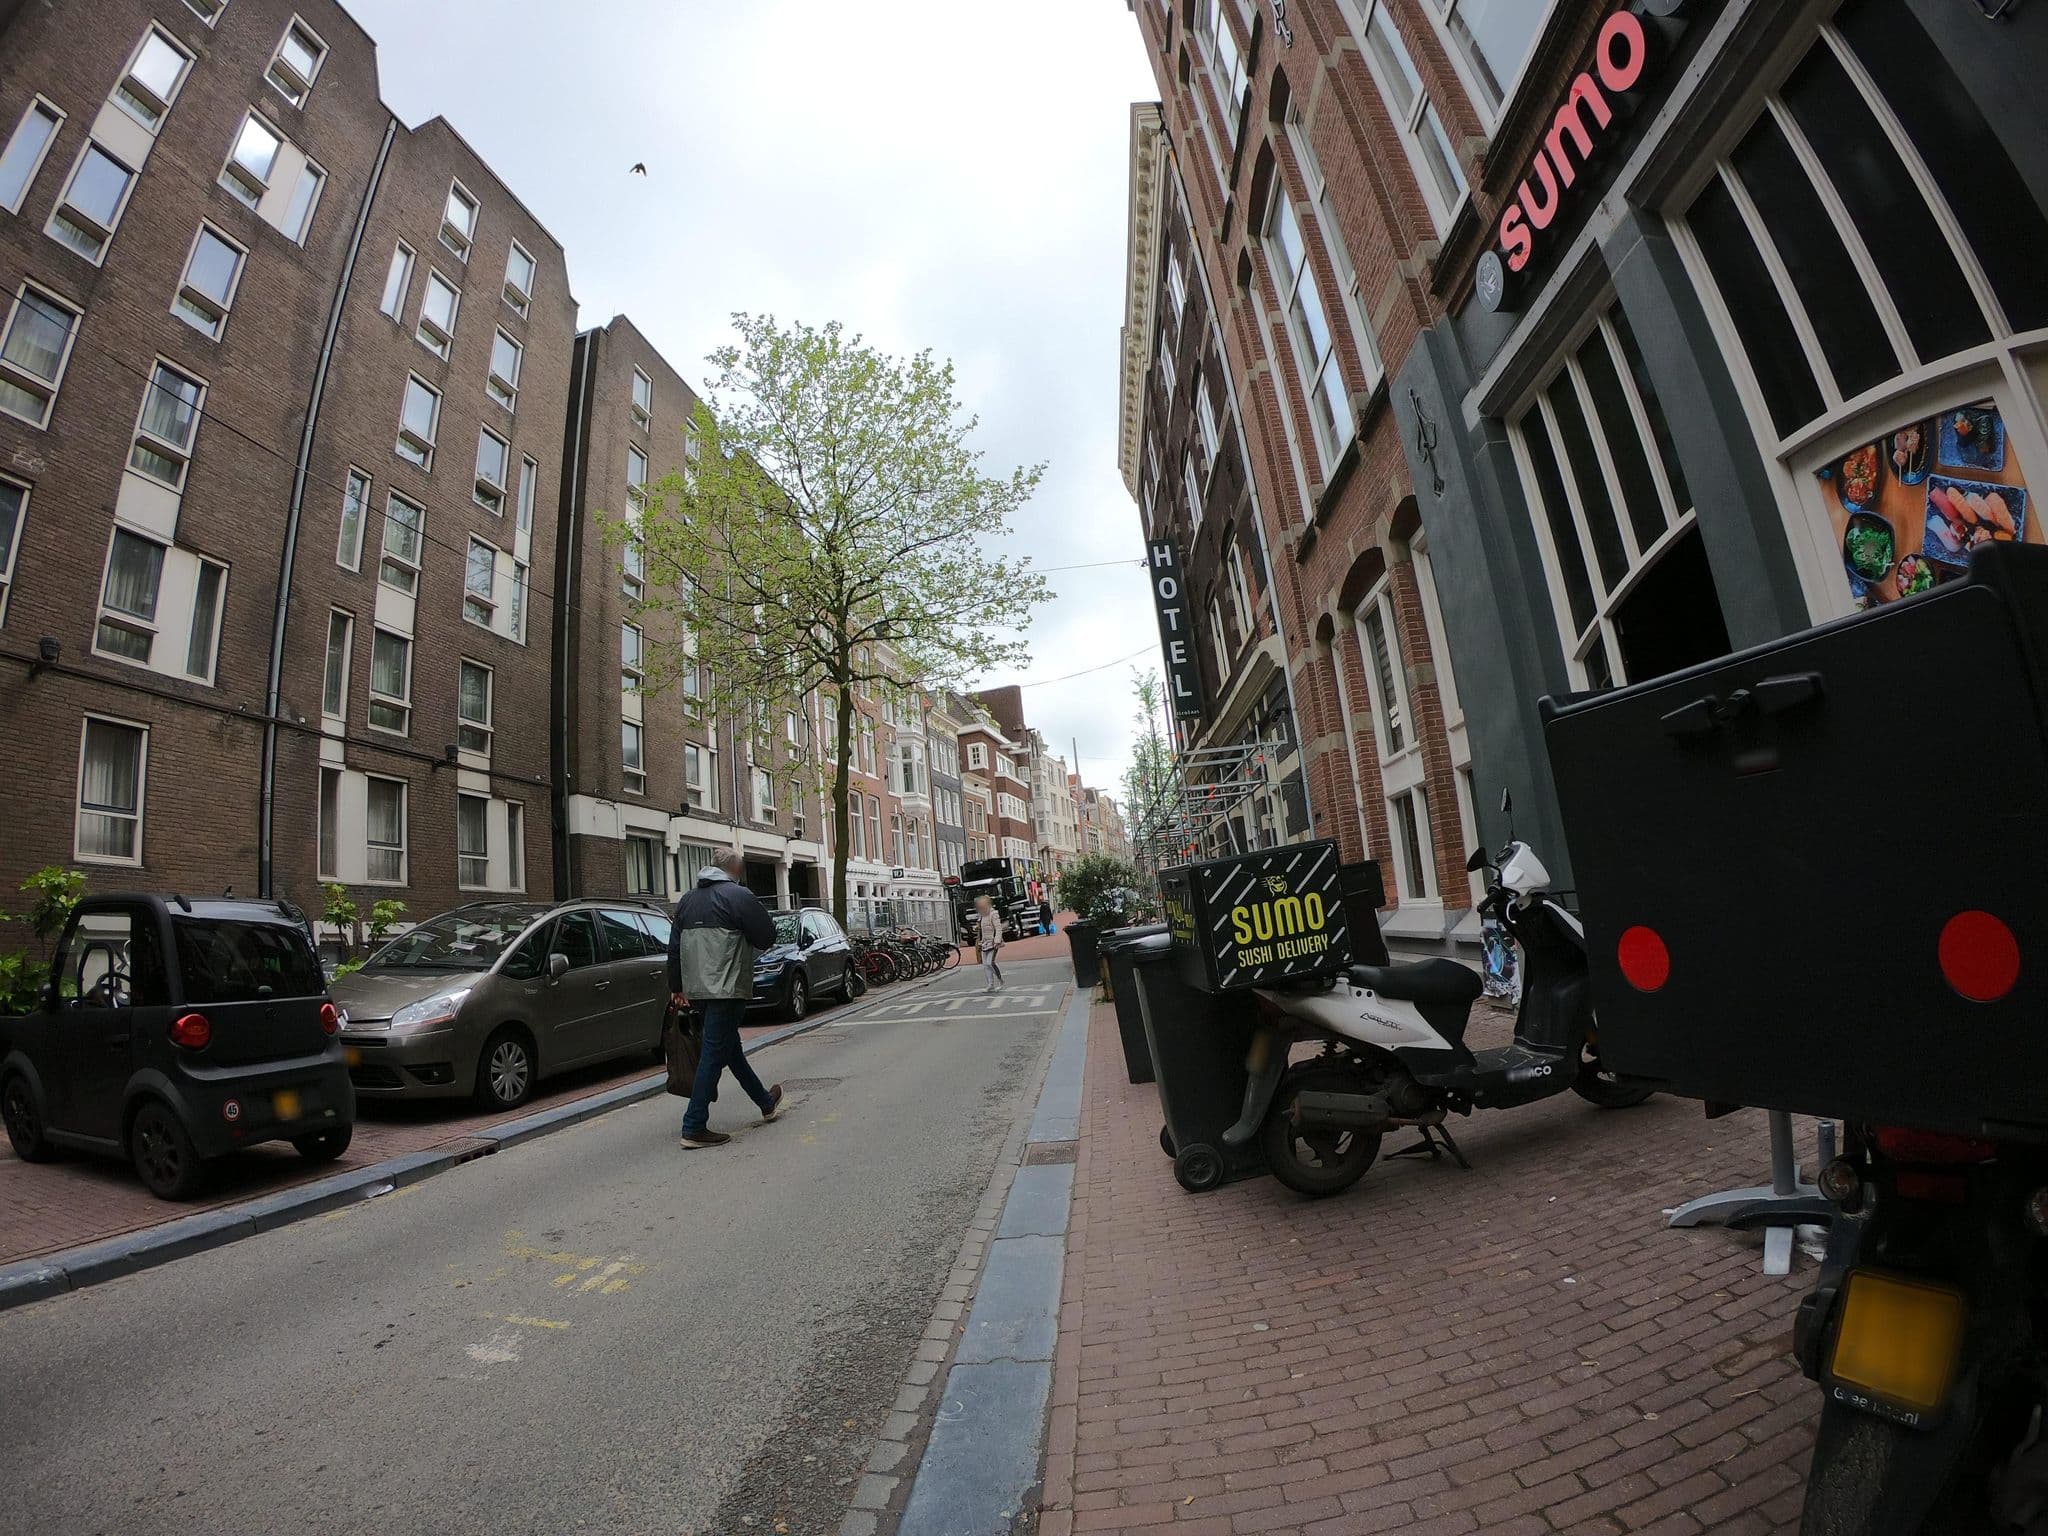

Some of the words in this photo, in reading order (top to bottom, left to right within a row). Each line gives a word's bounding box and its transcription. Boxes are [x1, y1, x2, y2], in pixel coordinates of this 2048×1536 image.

[1153, 545, 1193, 698] HOTEL
[1231, 892, 1326, 945] SUMO
[1238, 945, 1273, 968] SUSHI
[1278, 933, 1329, 960] DELIVERY
